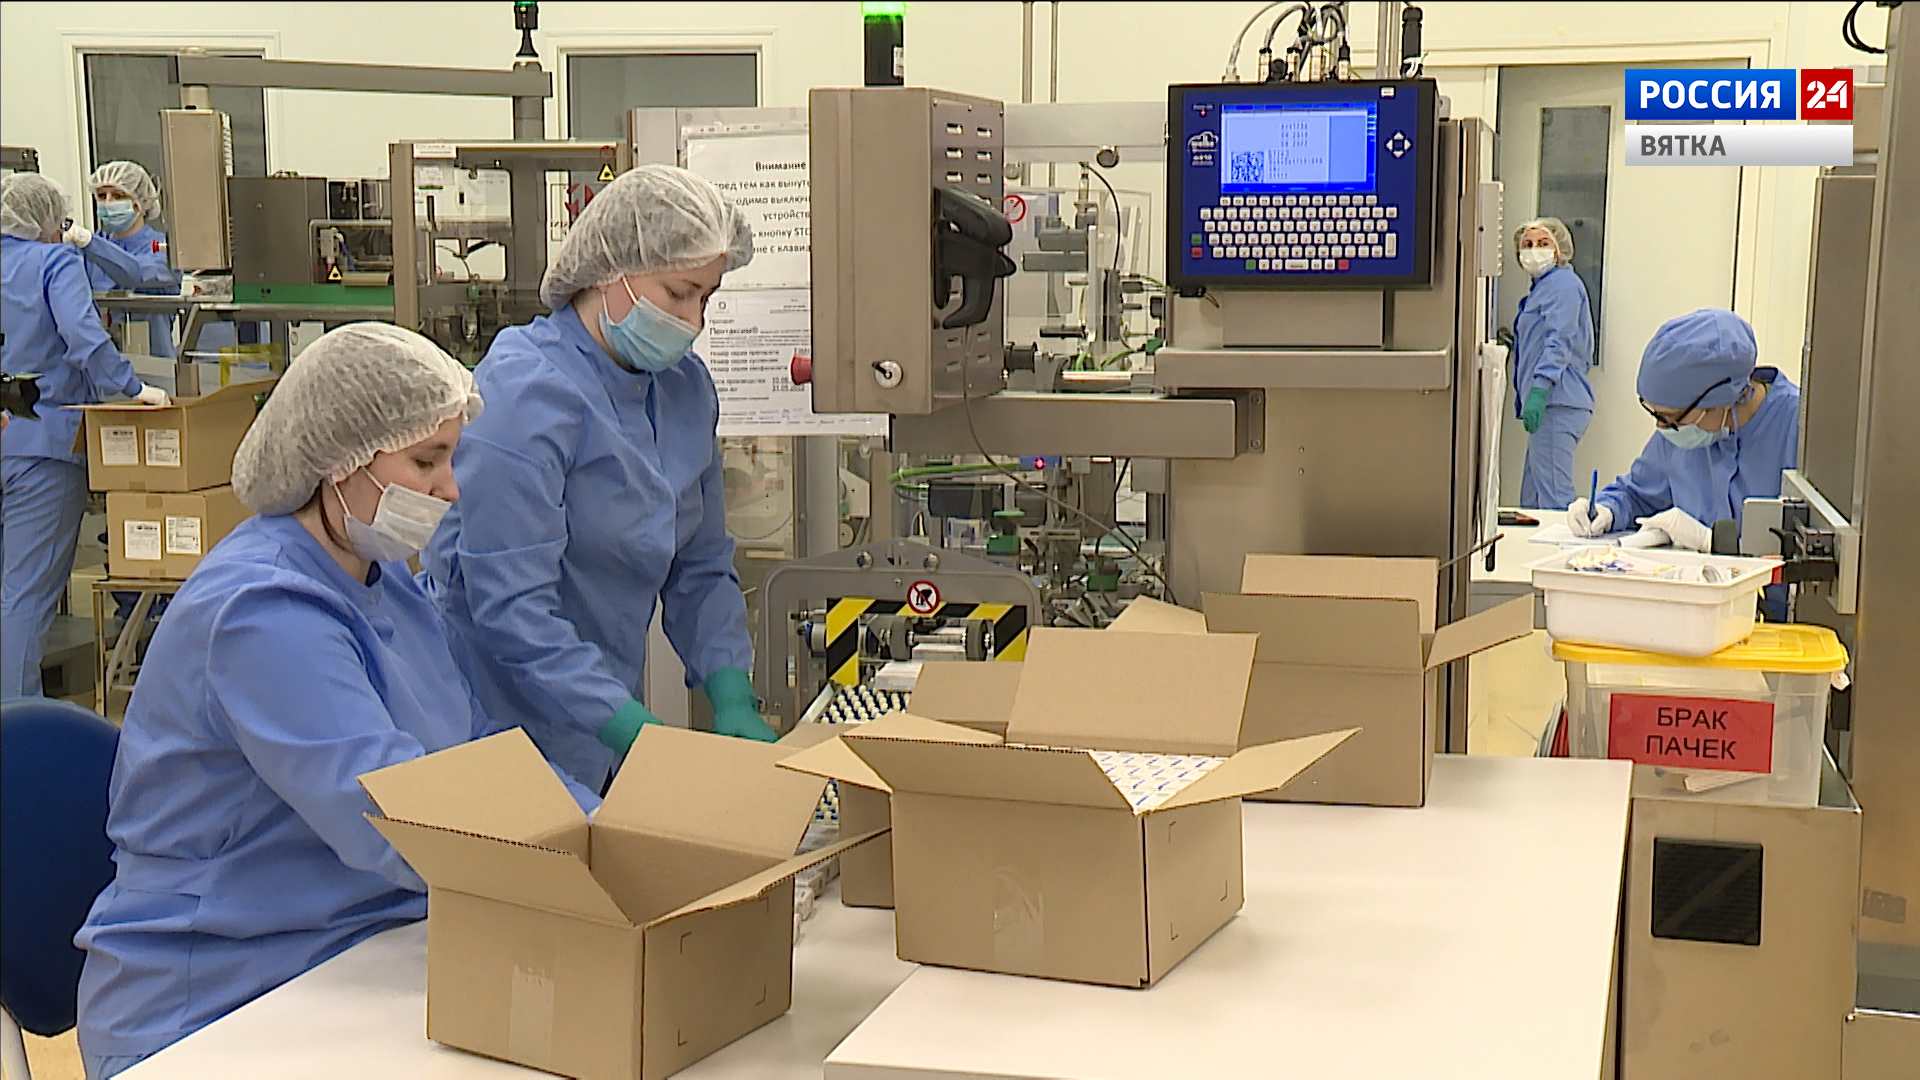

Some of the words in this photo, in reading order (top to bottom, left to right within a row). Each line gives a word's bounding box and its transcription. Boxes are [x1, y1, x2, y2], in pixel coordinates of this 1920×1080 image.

[755, 161, 807, 172] Внимание
[739, 181, 757, 190] тем
[759, 180, 776, 189] как
[735, 196, 769, 206] одимо
[1657, 707, 1729, 730] БРАК
[1646, 734, 1737, 760] ПАЧЕК
